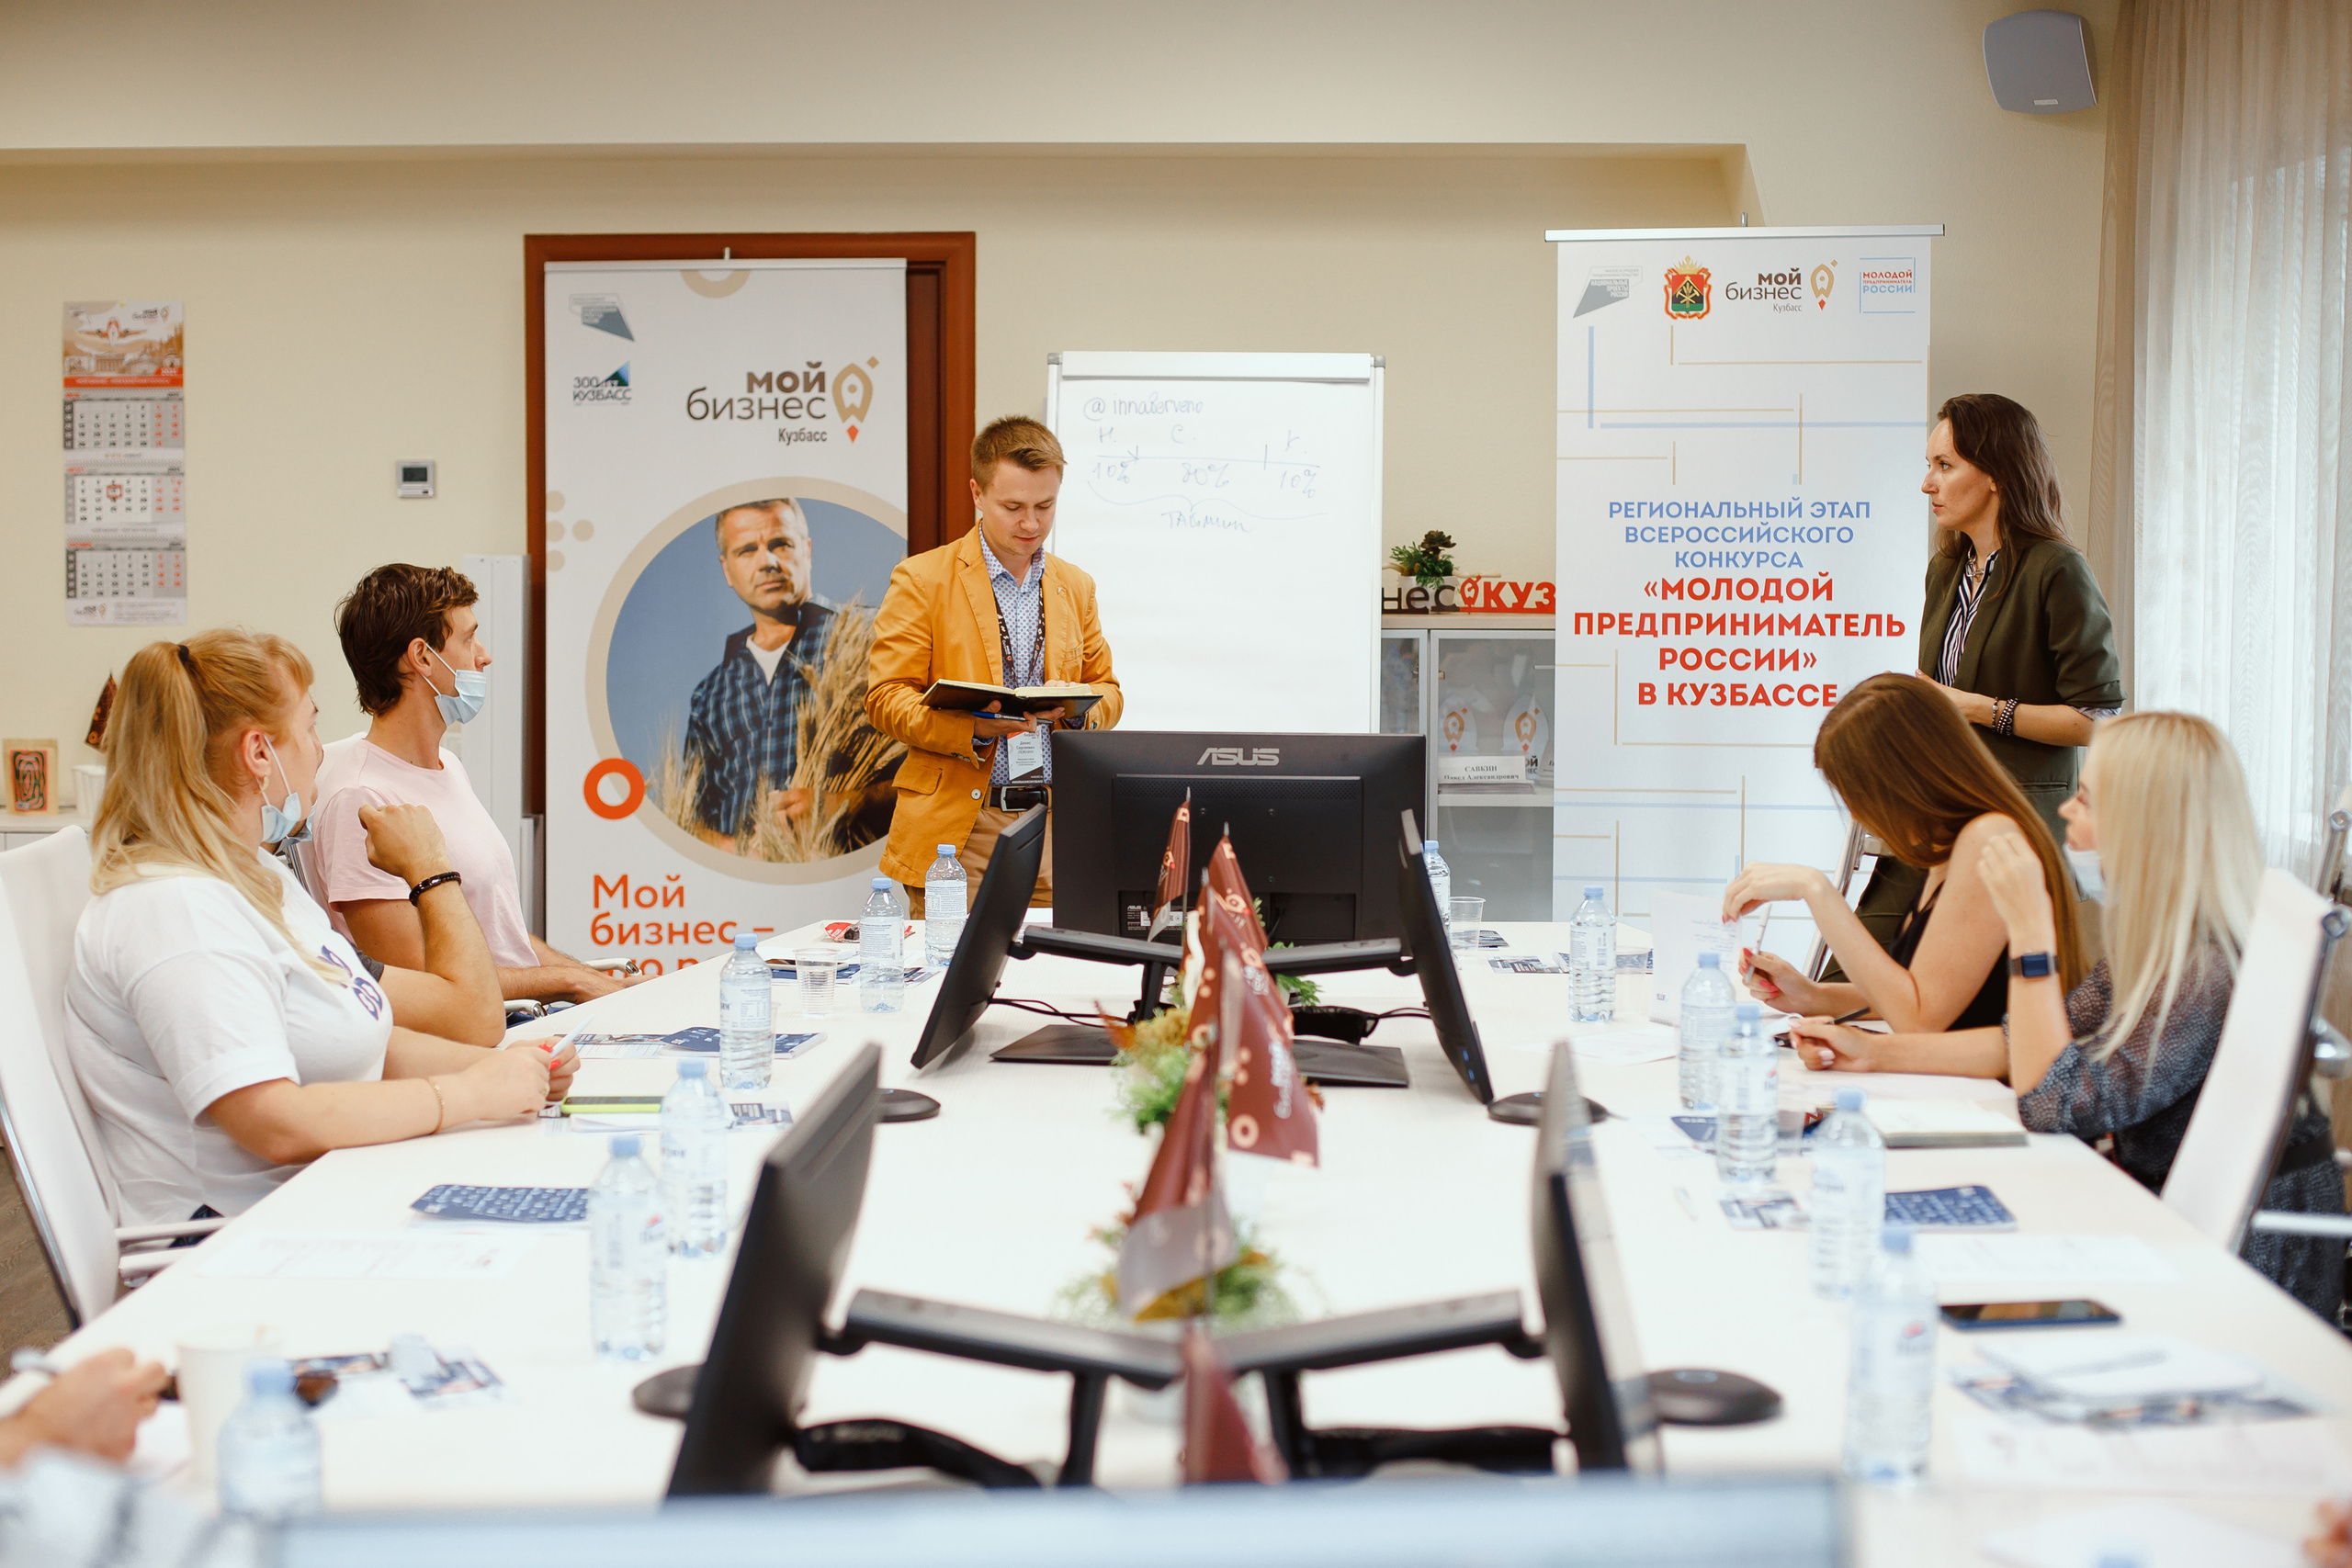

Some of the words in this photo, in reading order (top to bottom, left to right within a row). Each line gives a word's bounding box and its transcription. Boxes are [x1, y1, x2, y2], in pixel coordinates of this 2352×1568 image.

[1758, 267, 1801, 285] мой
[1862, 269, 1912, 278] МОЛОДОЙ
[1725, 281, 1802, 300] бизнес
[1862, 285, 1912, 293] РОССИИ
[1773, 303, 1802, 313] Кузбасс
[747, 361, 825, 393] мой
[573, 389, 631, 401] КУЗБАСС
[686, 387, 827, 421] бизнес
[778, 427, 827, 446] Кузбасс
[1609, 497, 1803, 518] РЕГИОНАЛЬНЫЙ
[1810, 502, 1871, 518] ЭТАП
[1625, 522, 1854, 543] ВСЕРОССИЙСКОГО
[1675, 551, 1804, 569] КОНКУРСА
[1644, 571, 1833, 604] «МОЛОДОЙ
[1574, 613, 1905, 637] ПРЕДПРИНИМАТЕЛЬ
[1659, 648, 1817, 671] РОССИИ»
[1638, 682, 1657, 705] В
[1668, 682, 1838, 706] КУЗБАССЕ
[1196, 747, 1280, 766] ASUS
[593, 874, 685, 909] Мой
[590, 911, 739, 946] бизнес
